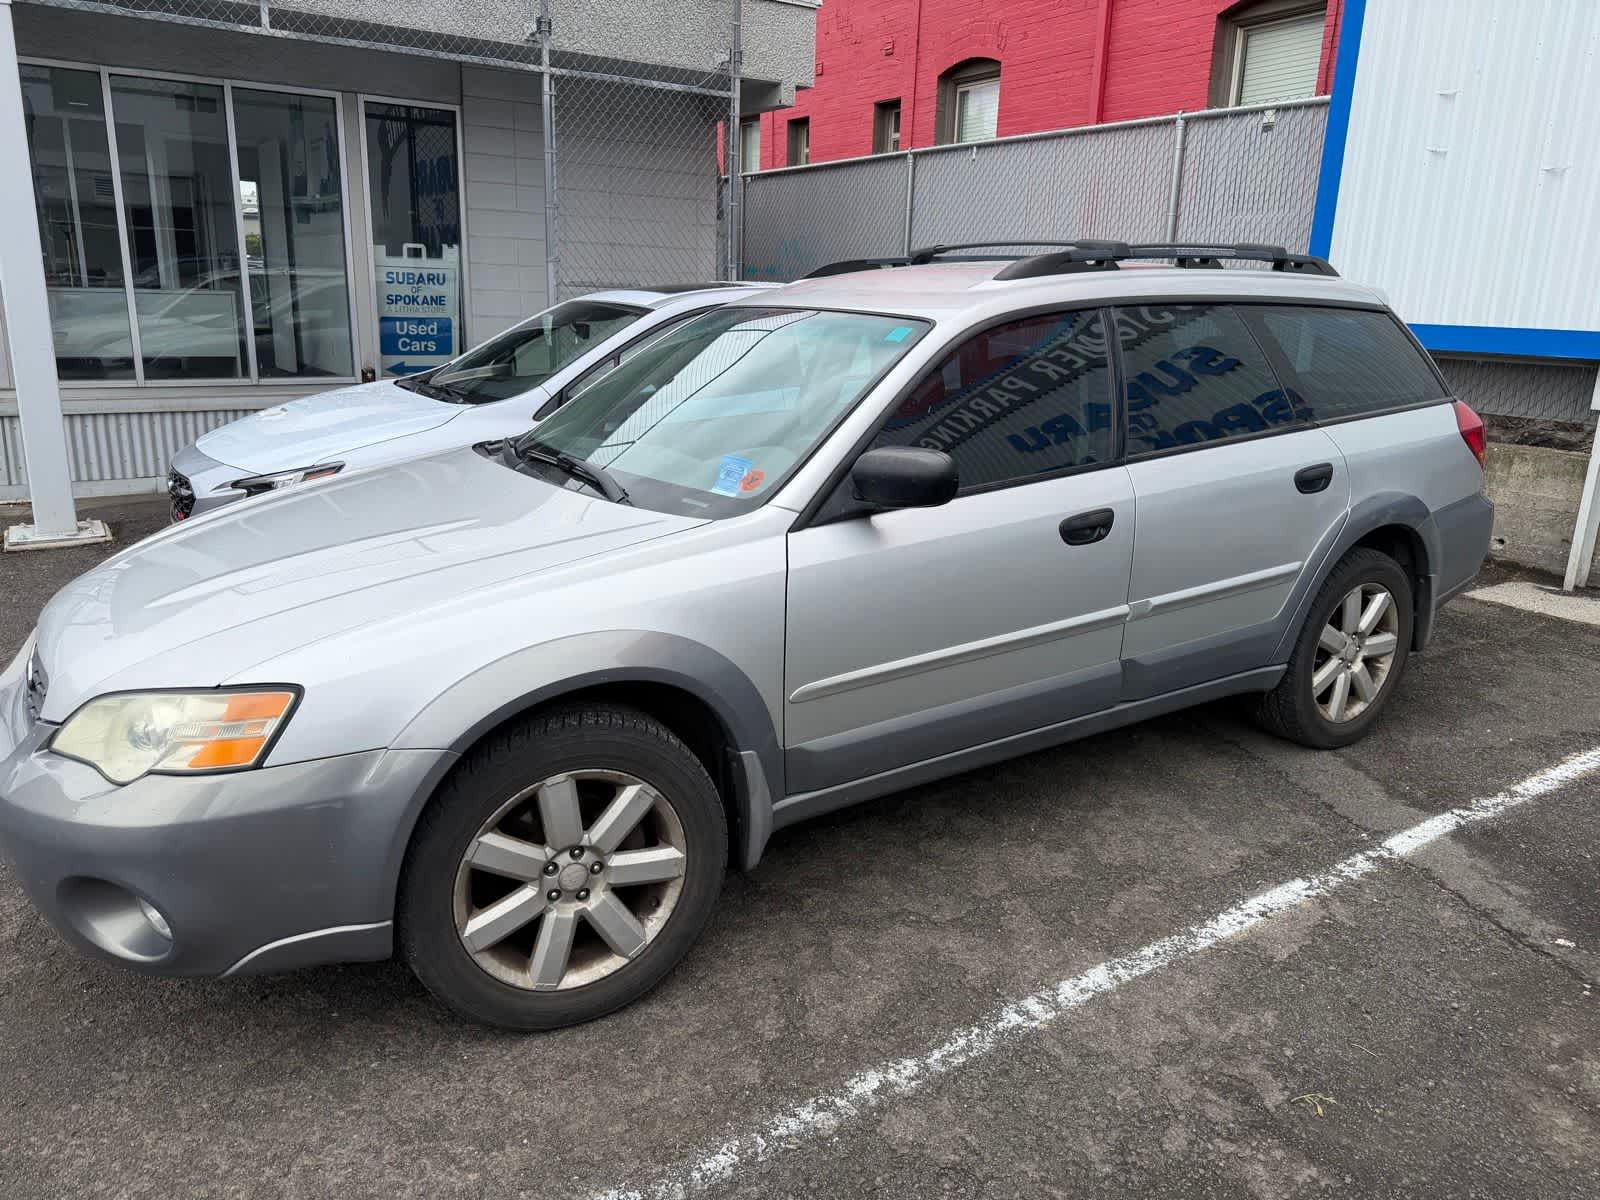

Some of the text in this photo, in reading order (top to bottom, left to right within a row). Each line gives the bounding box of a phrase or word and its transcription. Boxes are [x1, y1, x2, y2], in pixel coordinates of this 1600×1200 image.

[386, 272, 446, 285] SUBARU
[386, 294, 446, 306] SPOKANE
[396, 321, 437, 335] Used
[398, 338, 436, 352] Cars
